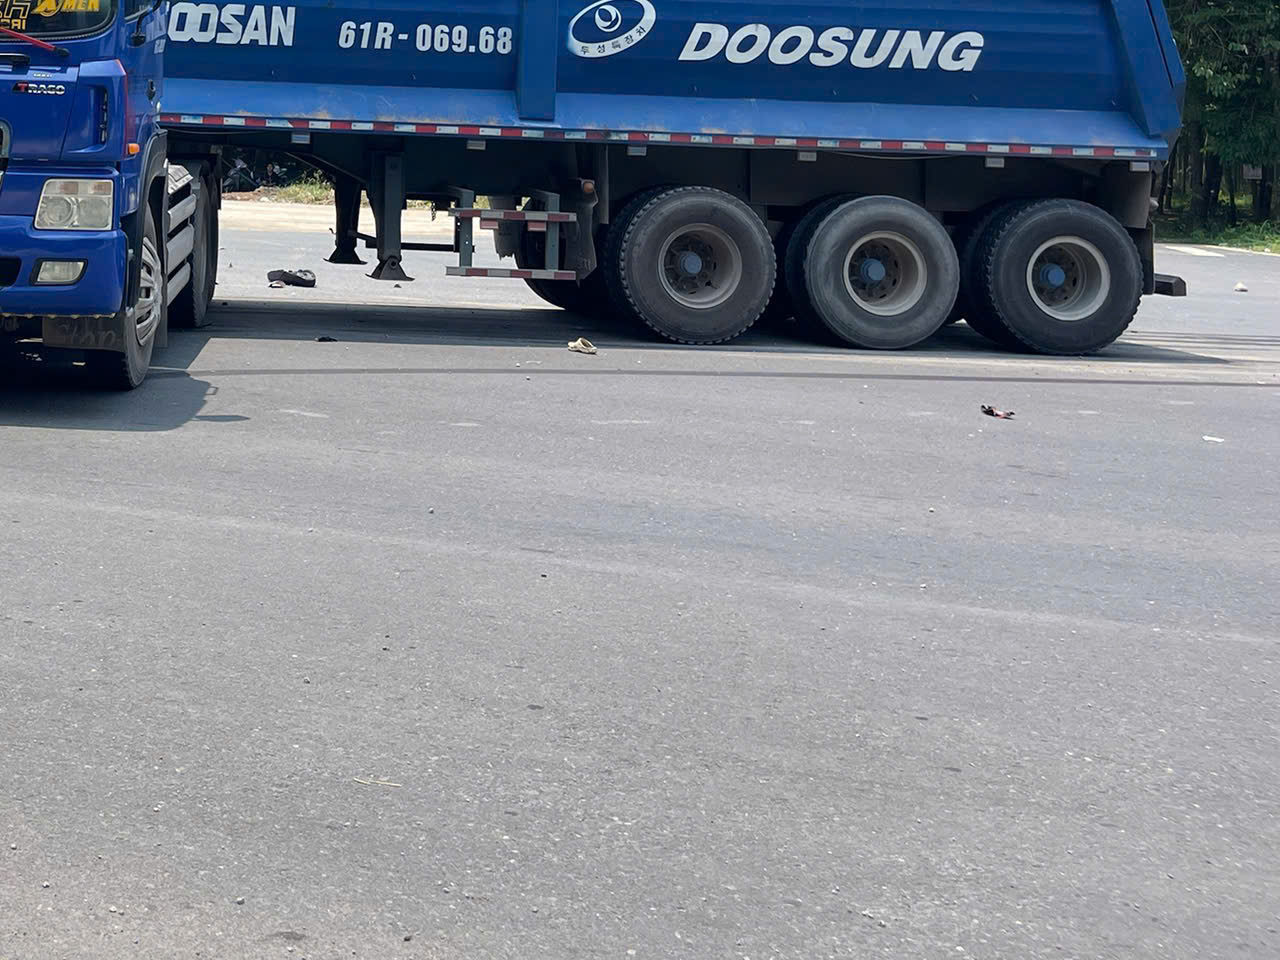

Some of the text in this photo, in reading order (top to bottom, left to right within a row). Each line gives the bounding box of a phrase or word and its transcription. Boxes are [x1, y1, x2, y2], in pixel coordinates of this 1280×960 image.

[166, 1, 296, 47] OOSAN
[678, 22, 985, 73] DOOSUNG
[16, 83, 66, 96] TRAGO
